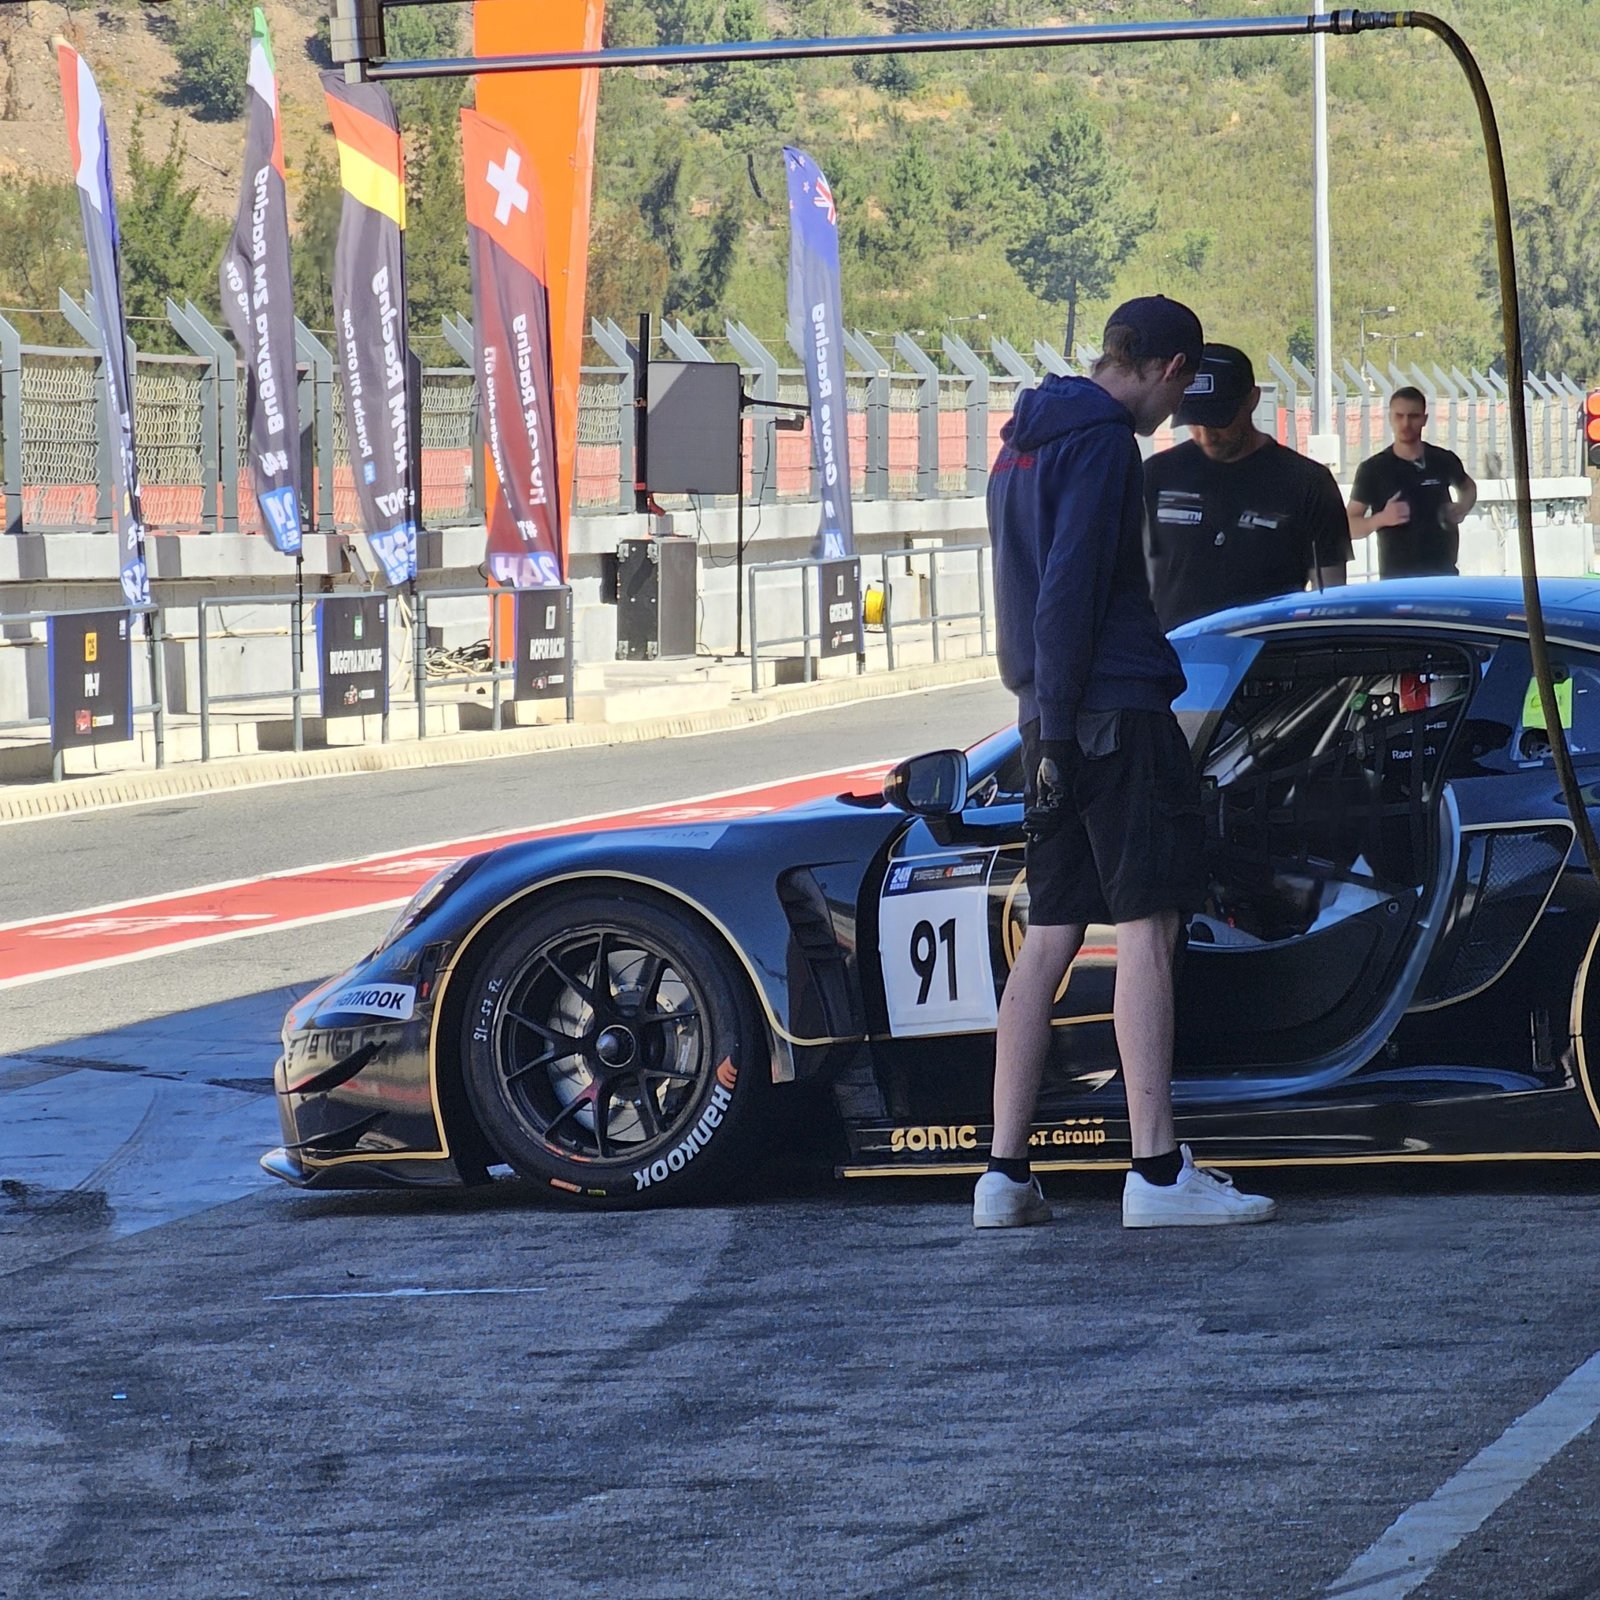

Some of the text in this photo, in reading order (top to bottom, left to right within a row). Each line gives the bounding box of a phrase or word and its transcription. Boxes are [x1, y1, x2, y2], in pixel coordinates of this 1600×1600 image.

[1391, 745, 1436, 760] Racch
[909, 918, 958, 1005] 91
[1052, 1129, 1106, 1147] Group
